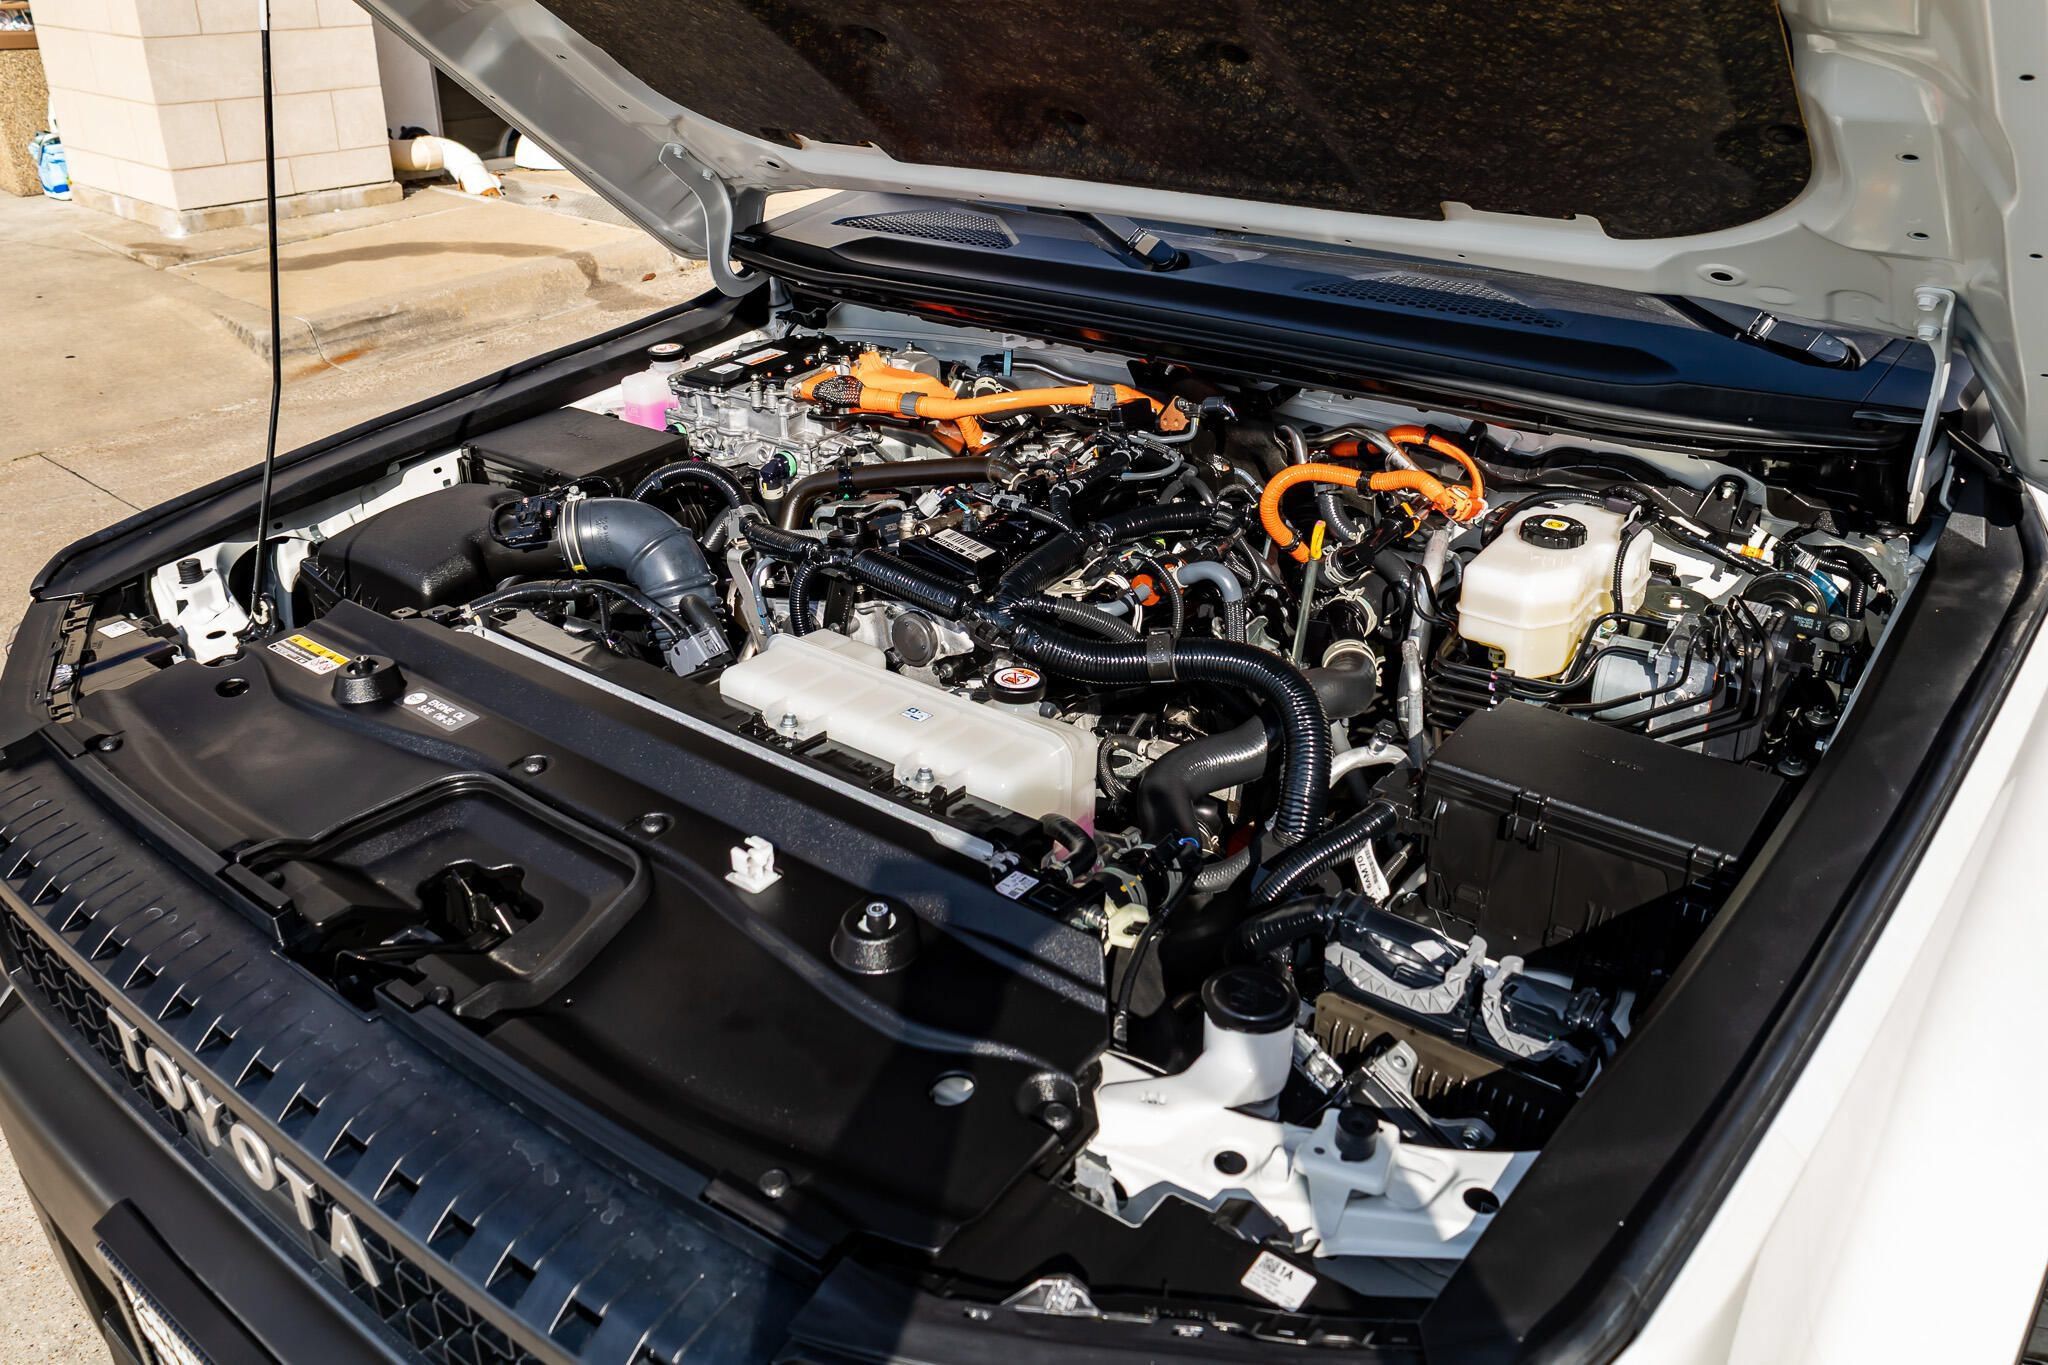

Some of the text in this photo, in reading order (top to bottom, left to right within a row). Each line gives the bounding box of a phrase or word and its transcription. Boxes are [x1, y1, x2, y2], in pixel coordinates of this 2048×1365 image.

[417, 704, 435, 715] SAE
[428, 700, 455, 714] ENGINE
[106, 1007, 381, 1287] TOYOTA
[1279, 1264, 1295, 1281] 1A
